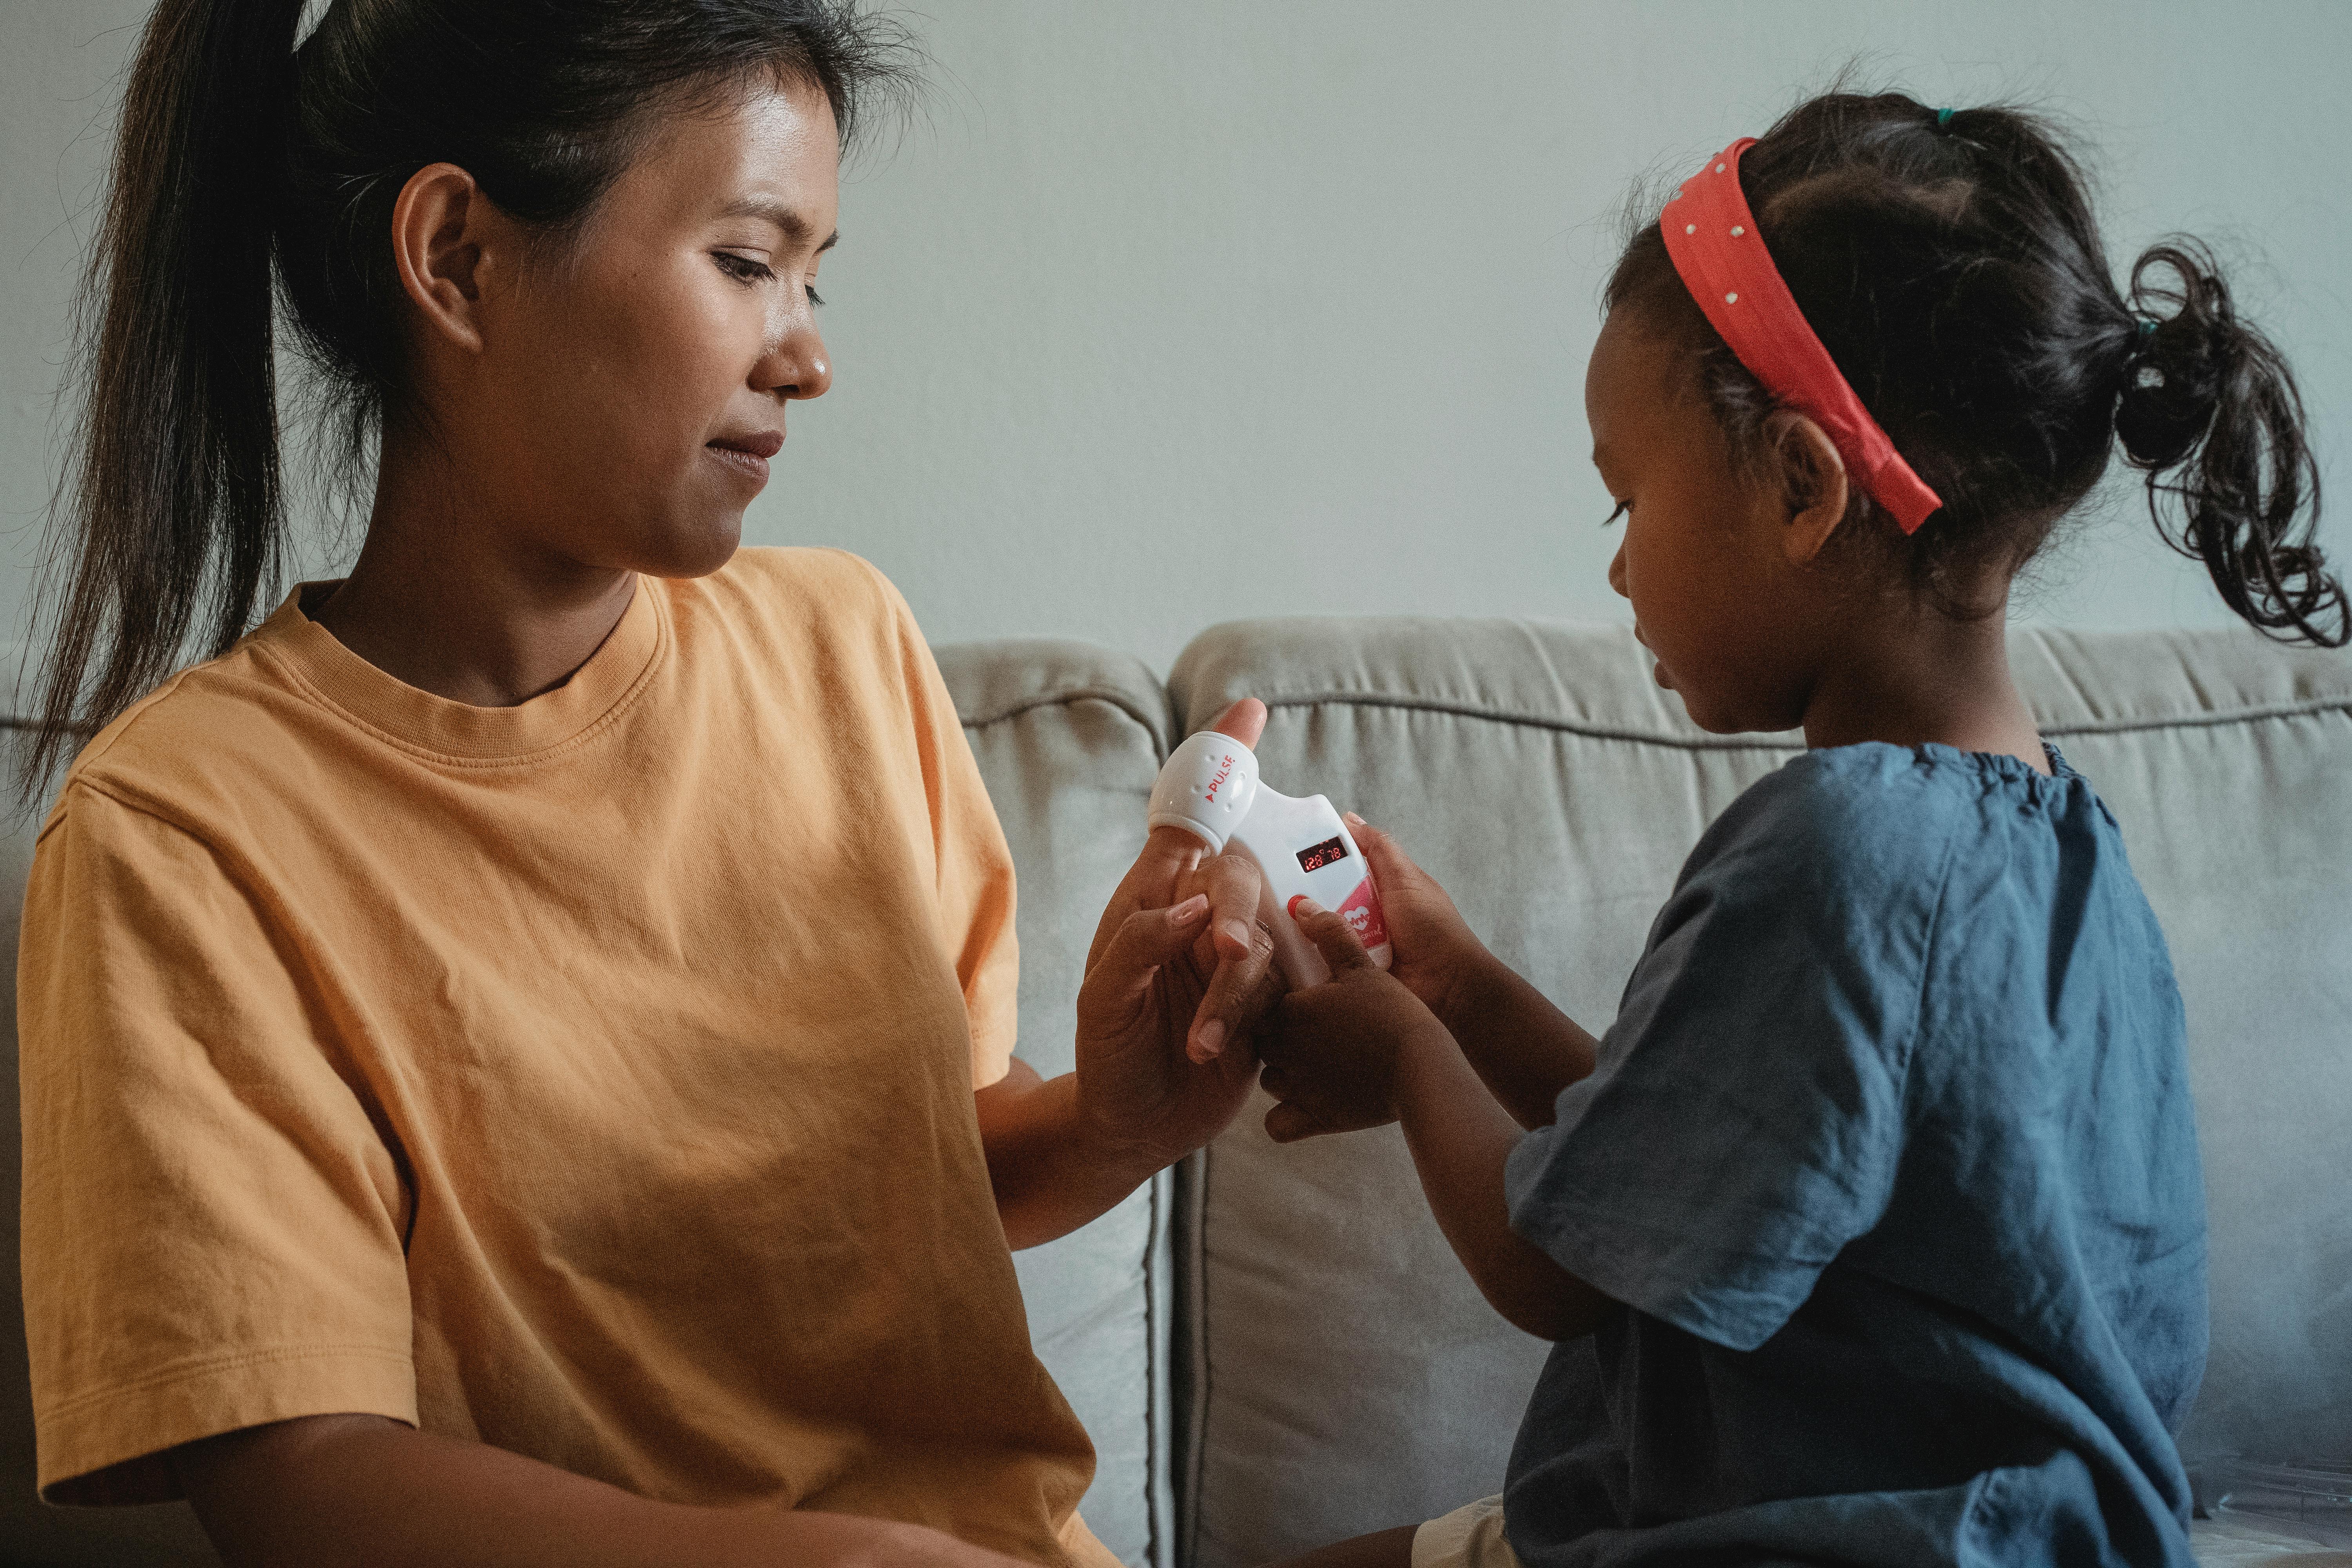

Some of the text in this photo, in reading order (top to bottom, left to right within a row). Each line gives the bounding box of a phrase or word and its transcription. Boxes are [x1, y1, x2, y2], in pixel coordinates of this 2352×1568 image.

[1208, 755, 1235, 792] PULSE
[1305, 848, 1341, 870] 128 78
